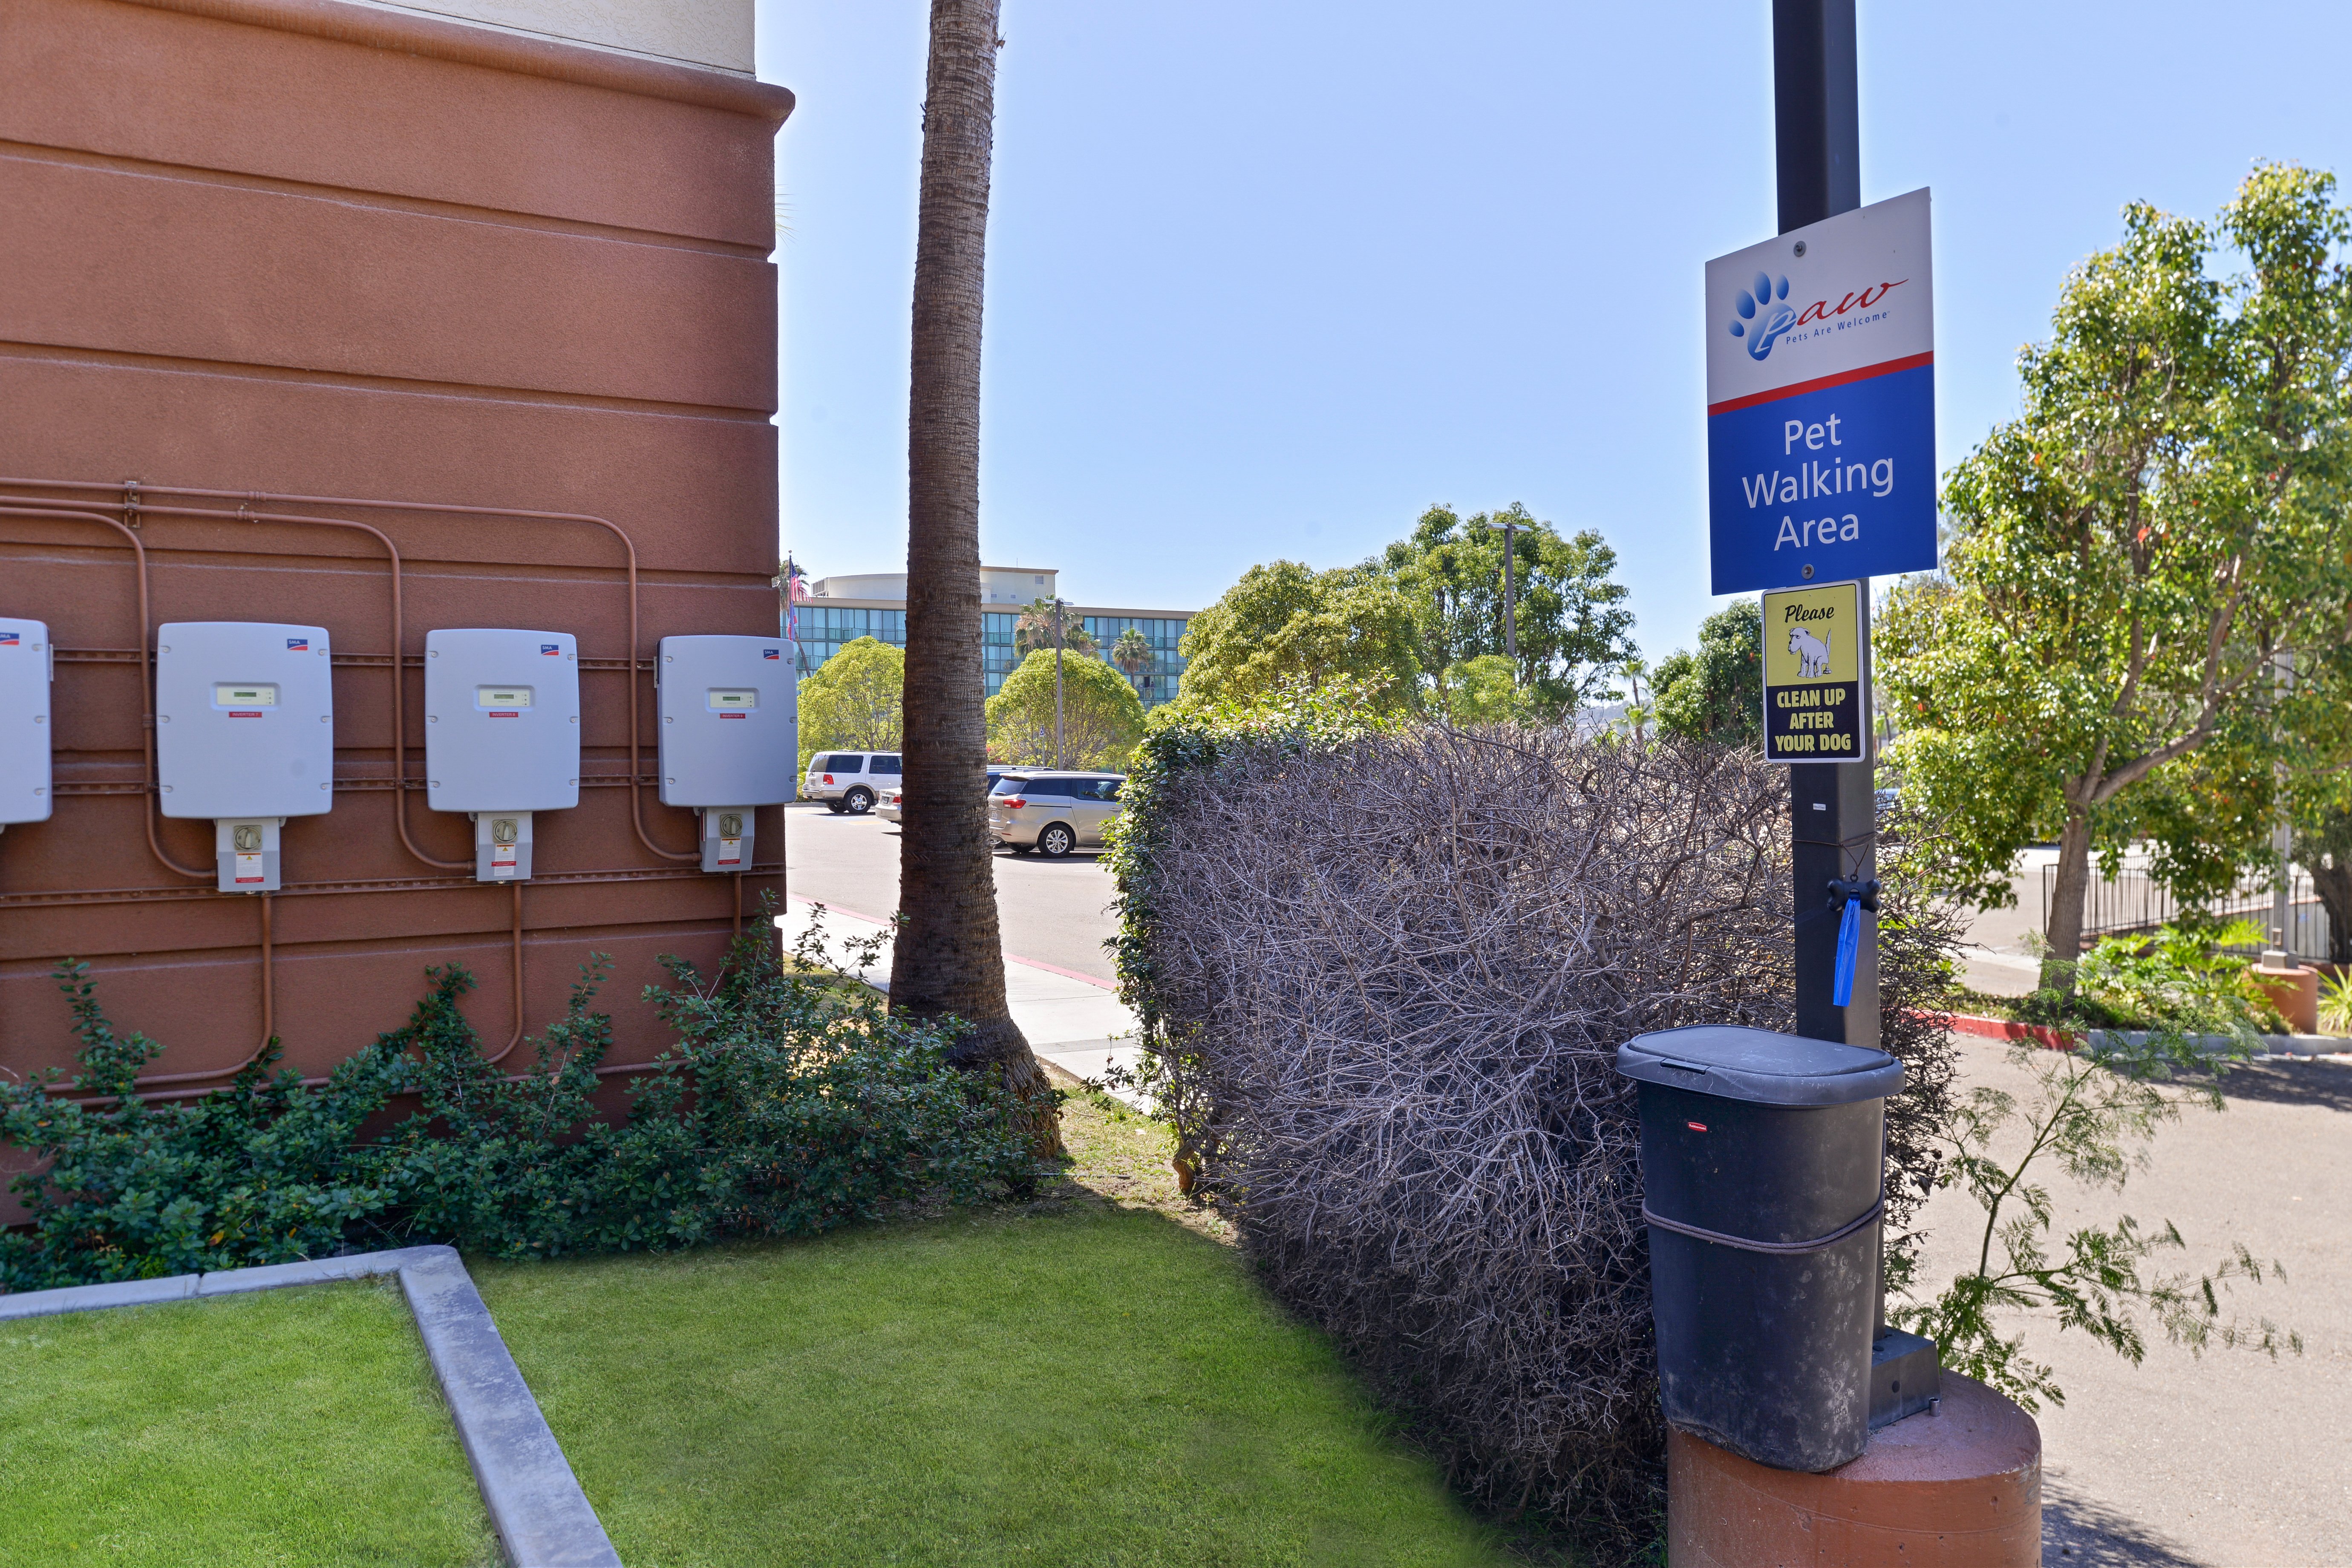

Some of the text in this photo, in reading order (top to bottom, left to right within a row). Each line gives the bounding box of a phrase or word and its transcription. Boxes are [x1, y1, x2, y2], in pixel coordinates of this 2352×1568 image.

[1786, 311, 1887, 344] Pets Are Welcome
[1784, 413, 1842, 455] Pet
[1742, 458, 1894, 508] Walking
[1774, 513, 1859, 551] Area
[1784, 604, 1834, 623] Please
[1777, 688, 1845, 708] CLEAN UP
[1790, 711, 1834, 729] AFTER
[1775, 733, 1851, 752] YOUR DOG
